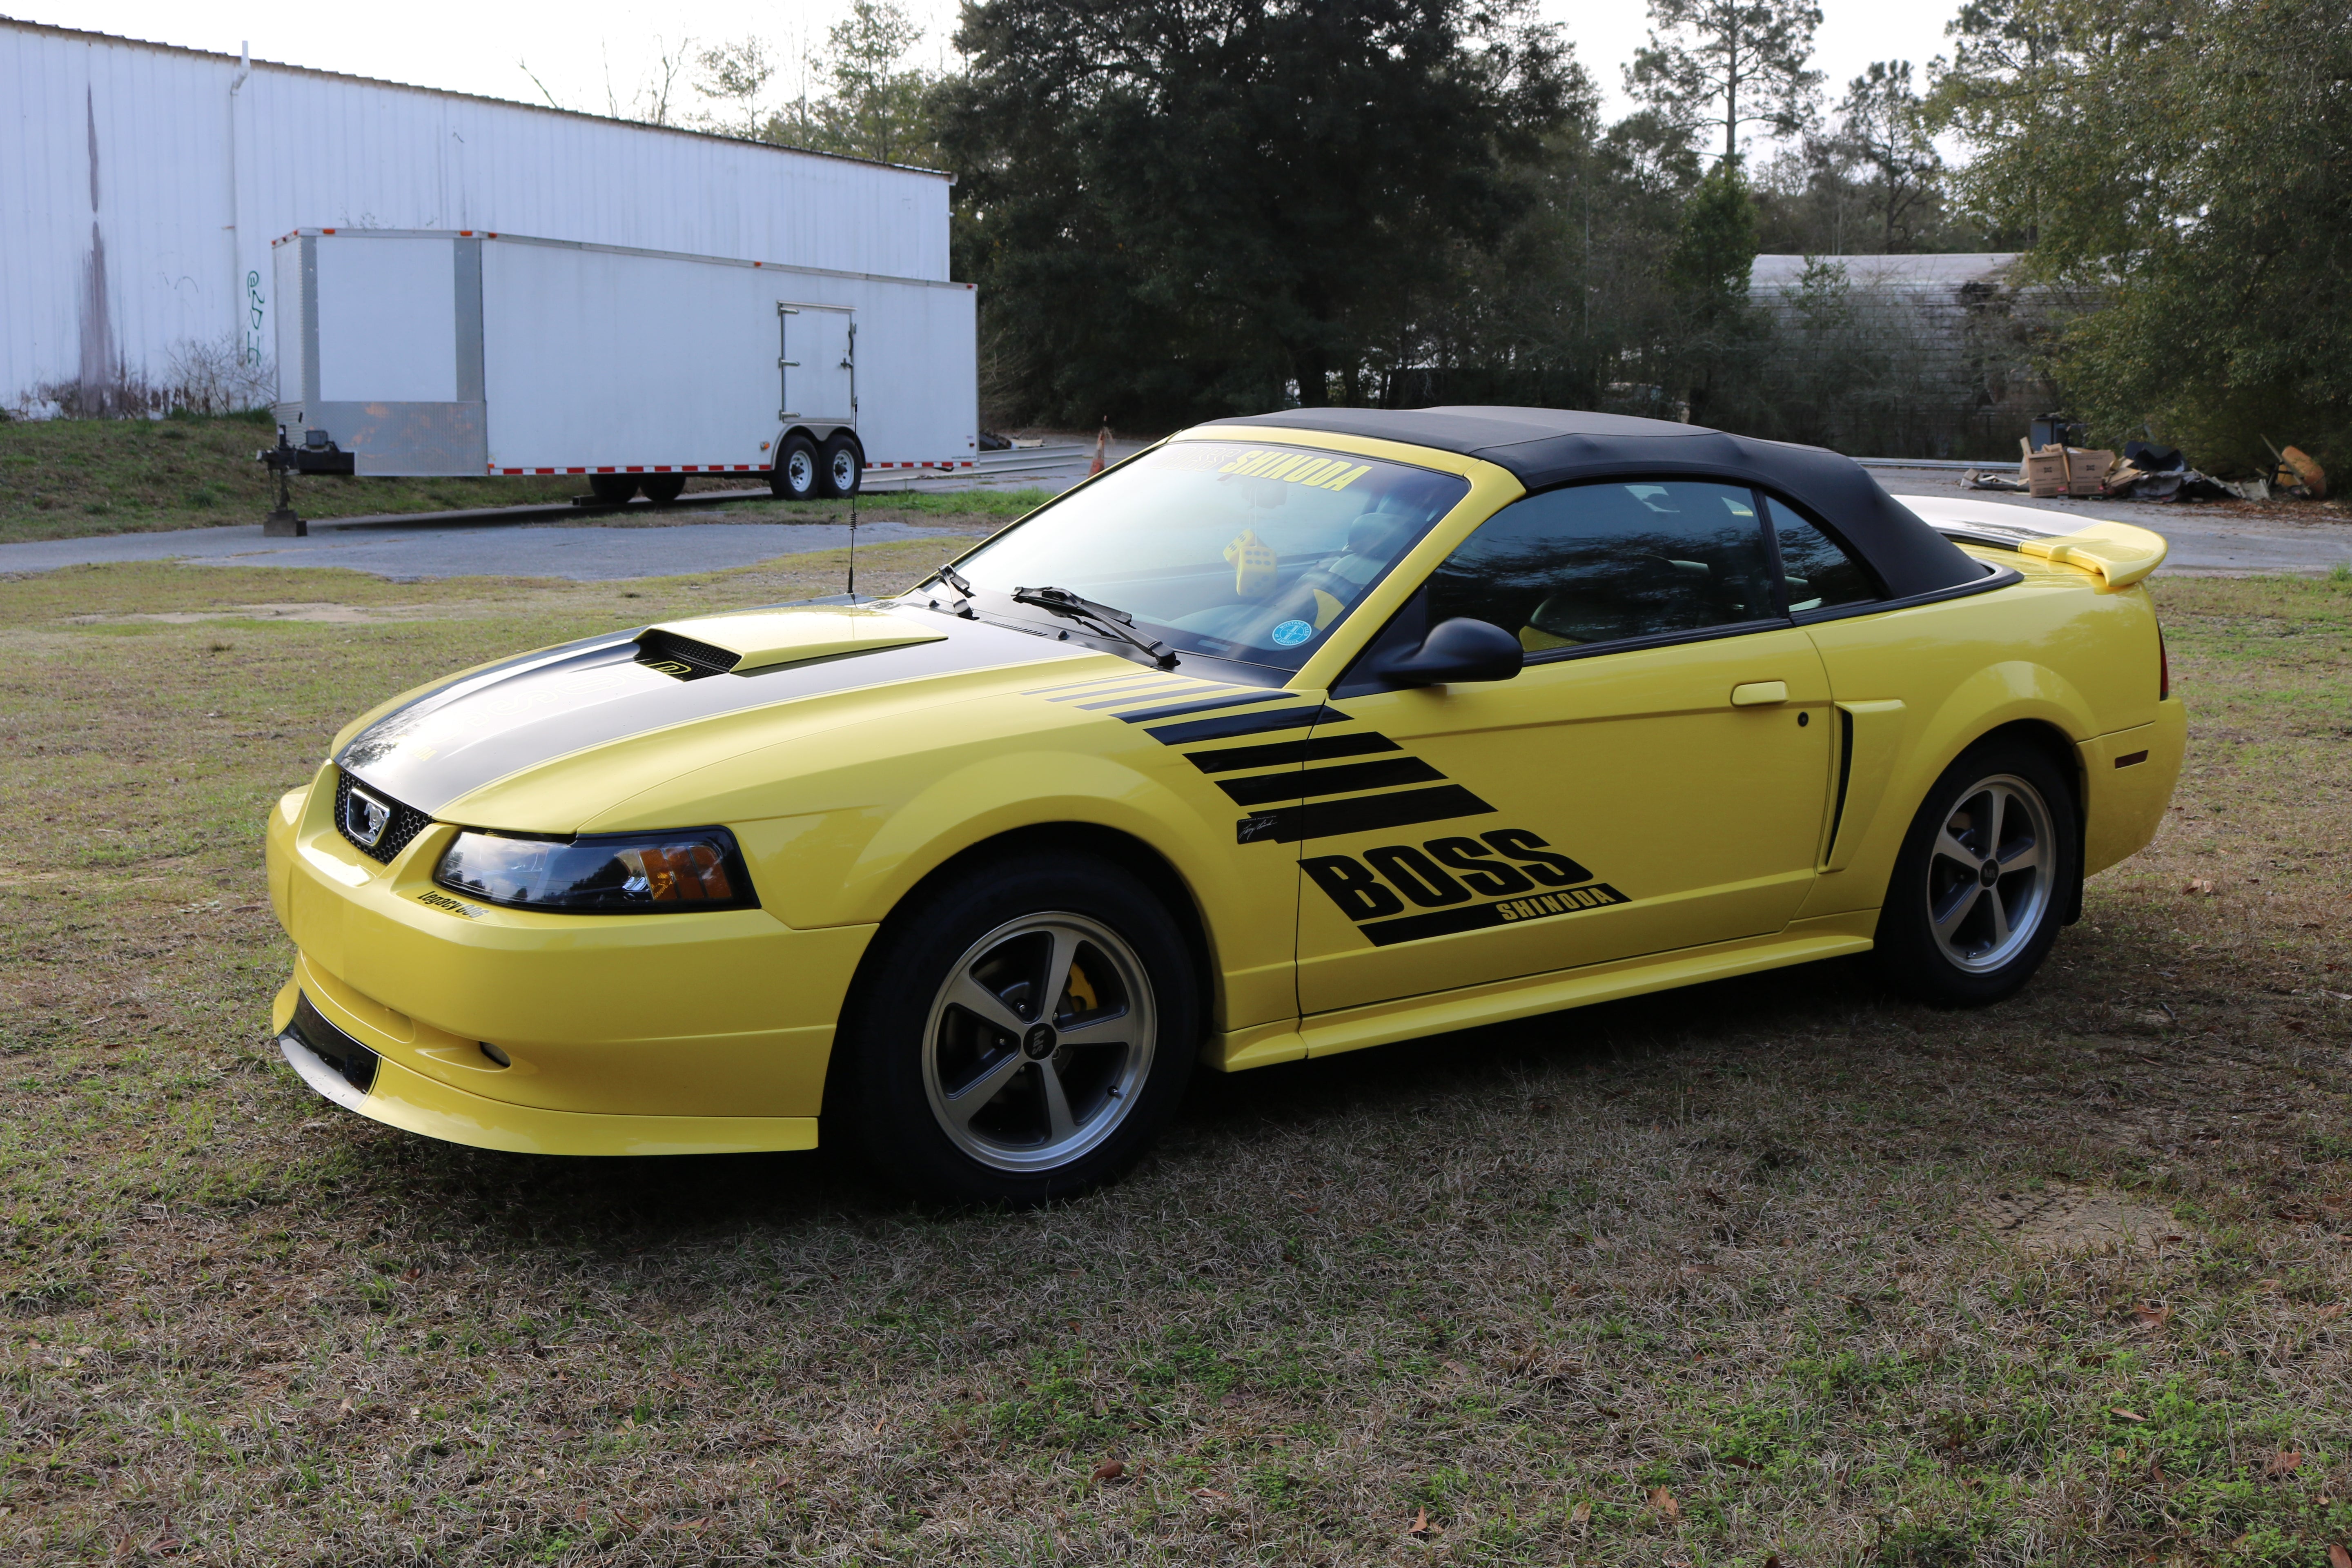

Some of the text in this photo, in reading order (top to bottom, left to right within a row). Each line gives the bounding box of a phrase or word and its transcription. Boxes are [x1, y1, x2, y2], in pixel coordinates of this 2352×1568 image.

[1150, 447, 1373, 492] BOSS SHINODA
[1296, 829, 1594, 922] BOSS
[417, 891, 490, 918] Legacy 006
[1496, 888, 1616, 921] SHINODA
